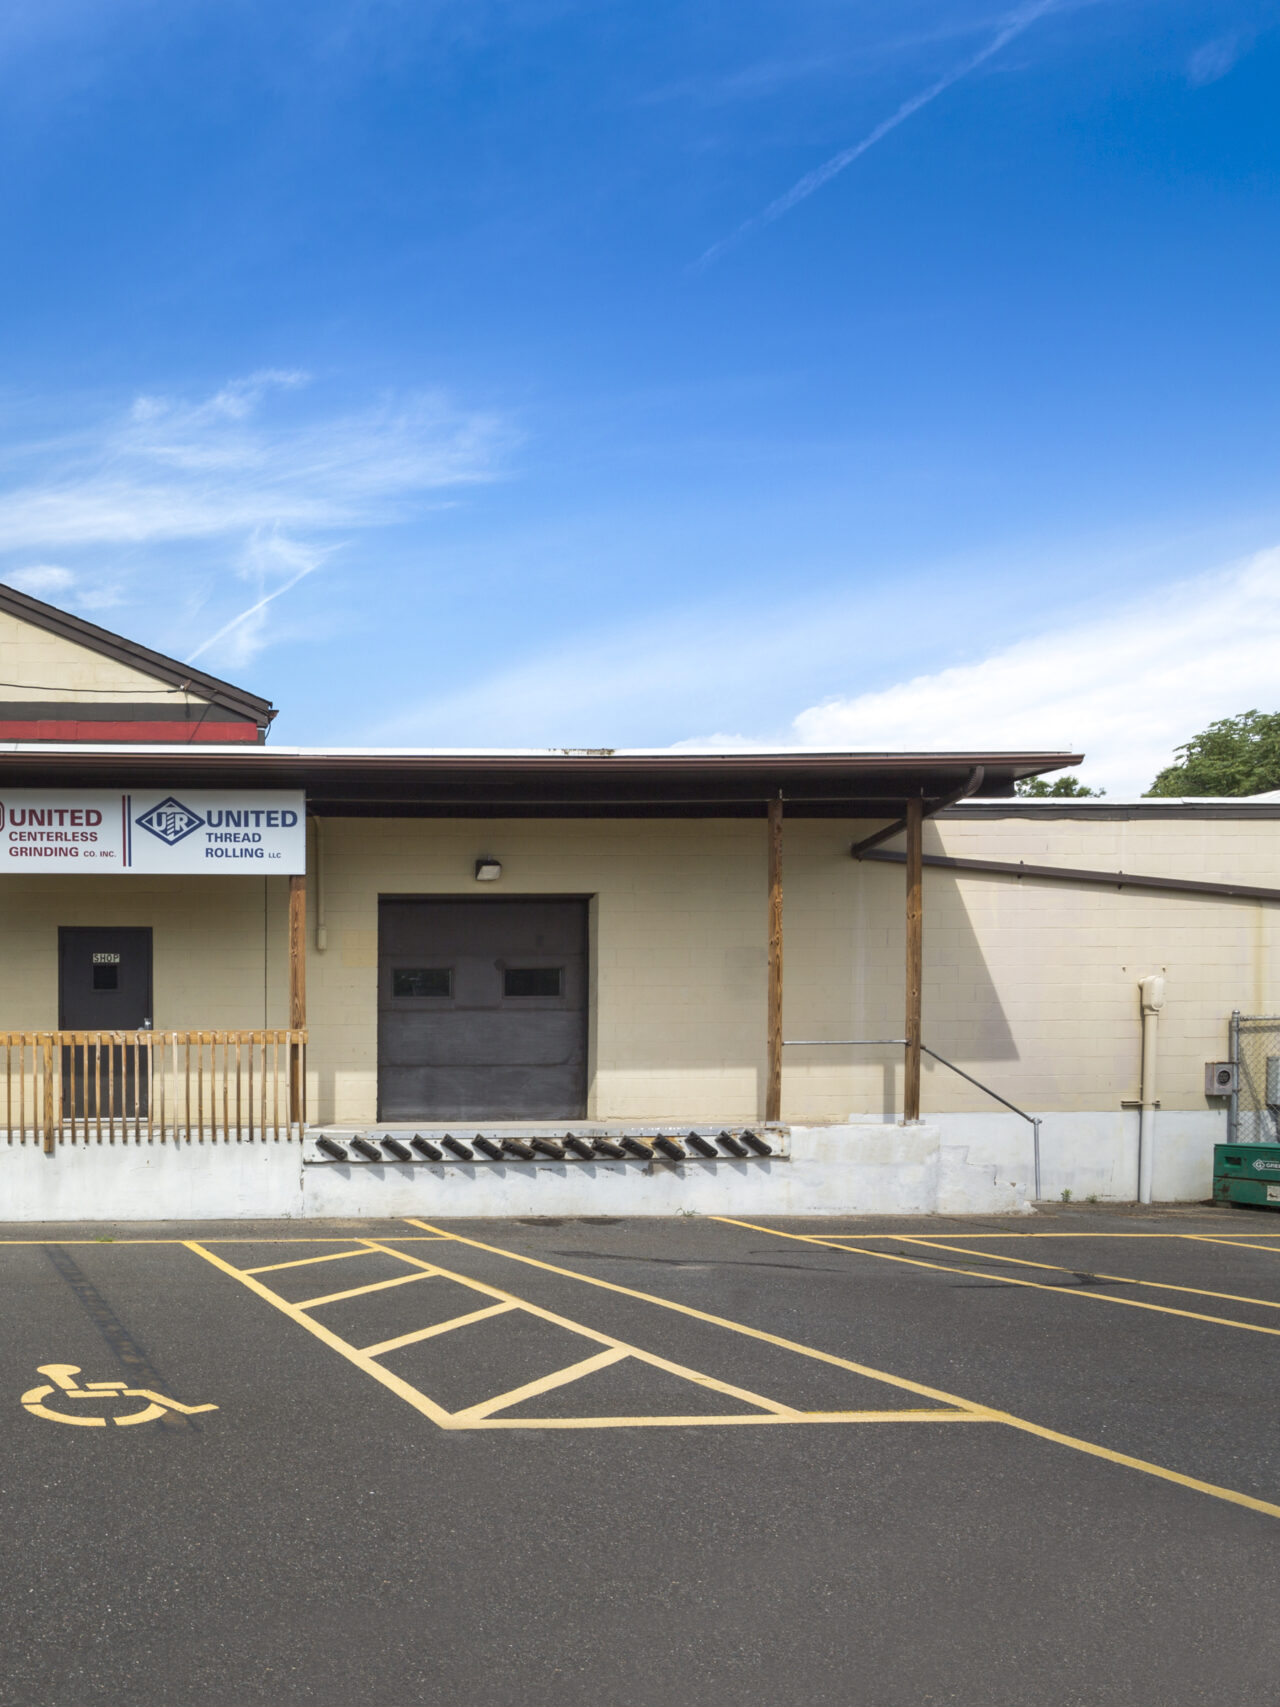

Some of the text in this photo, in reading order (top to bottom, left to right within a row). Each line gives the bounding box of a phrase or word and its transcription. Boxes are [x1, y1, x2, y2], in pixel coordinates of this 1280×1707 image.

[9, 809, 103, 827] UNITED
[206, 810, 298, 828] UNITED
[8, 831, 98, 842] CENTERLESS
[206, 832, 262, 843] THREAD
[8, 846, 117, 858] GRINDING CO. INC.
[205, 847, 264, 858] ROLLING
[93, 953, 120, 963] SHOP
